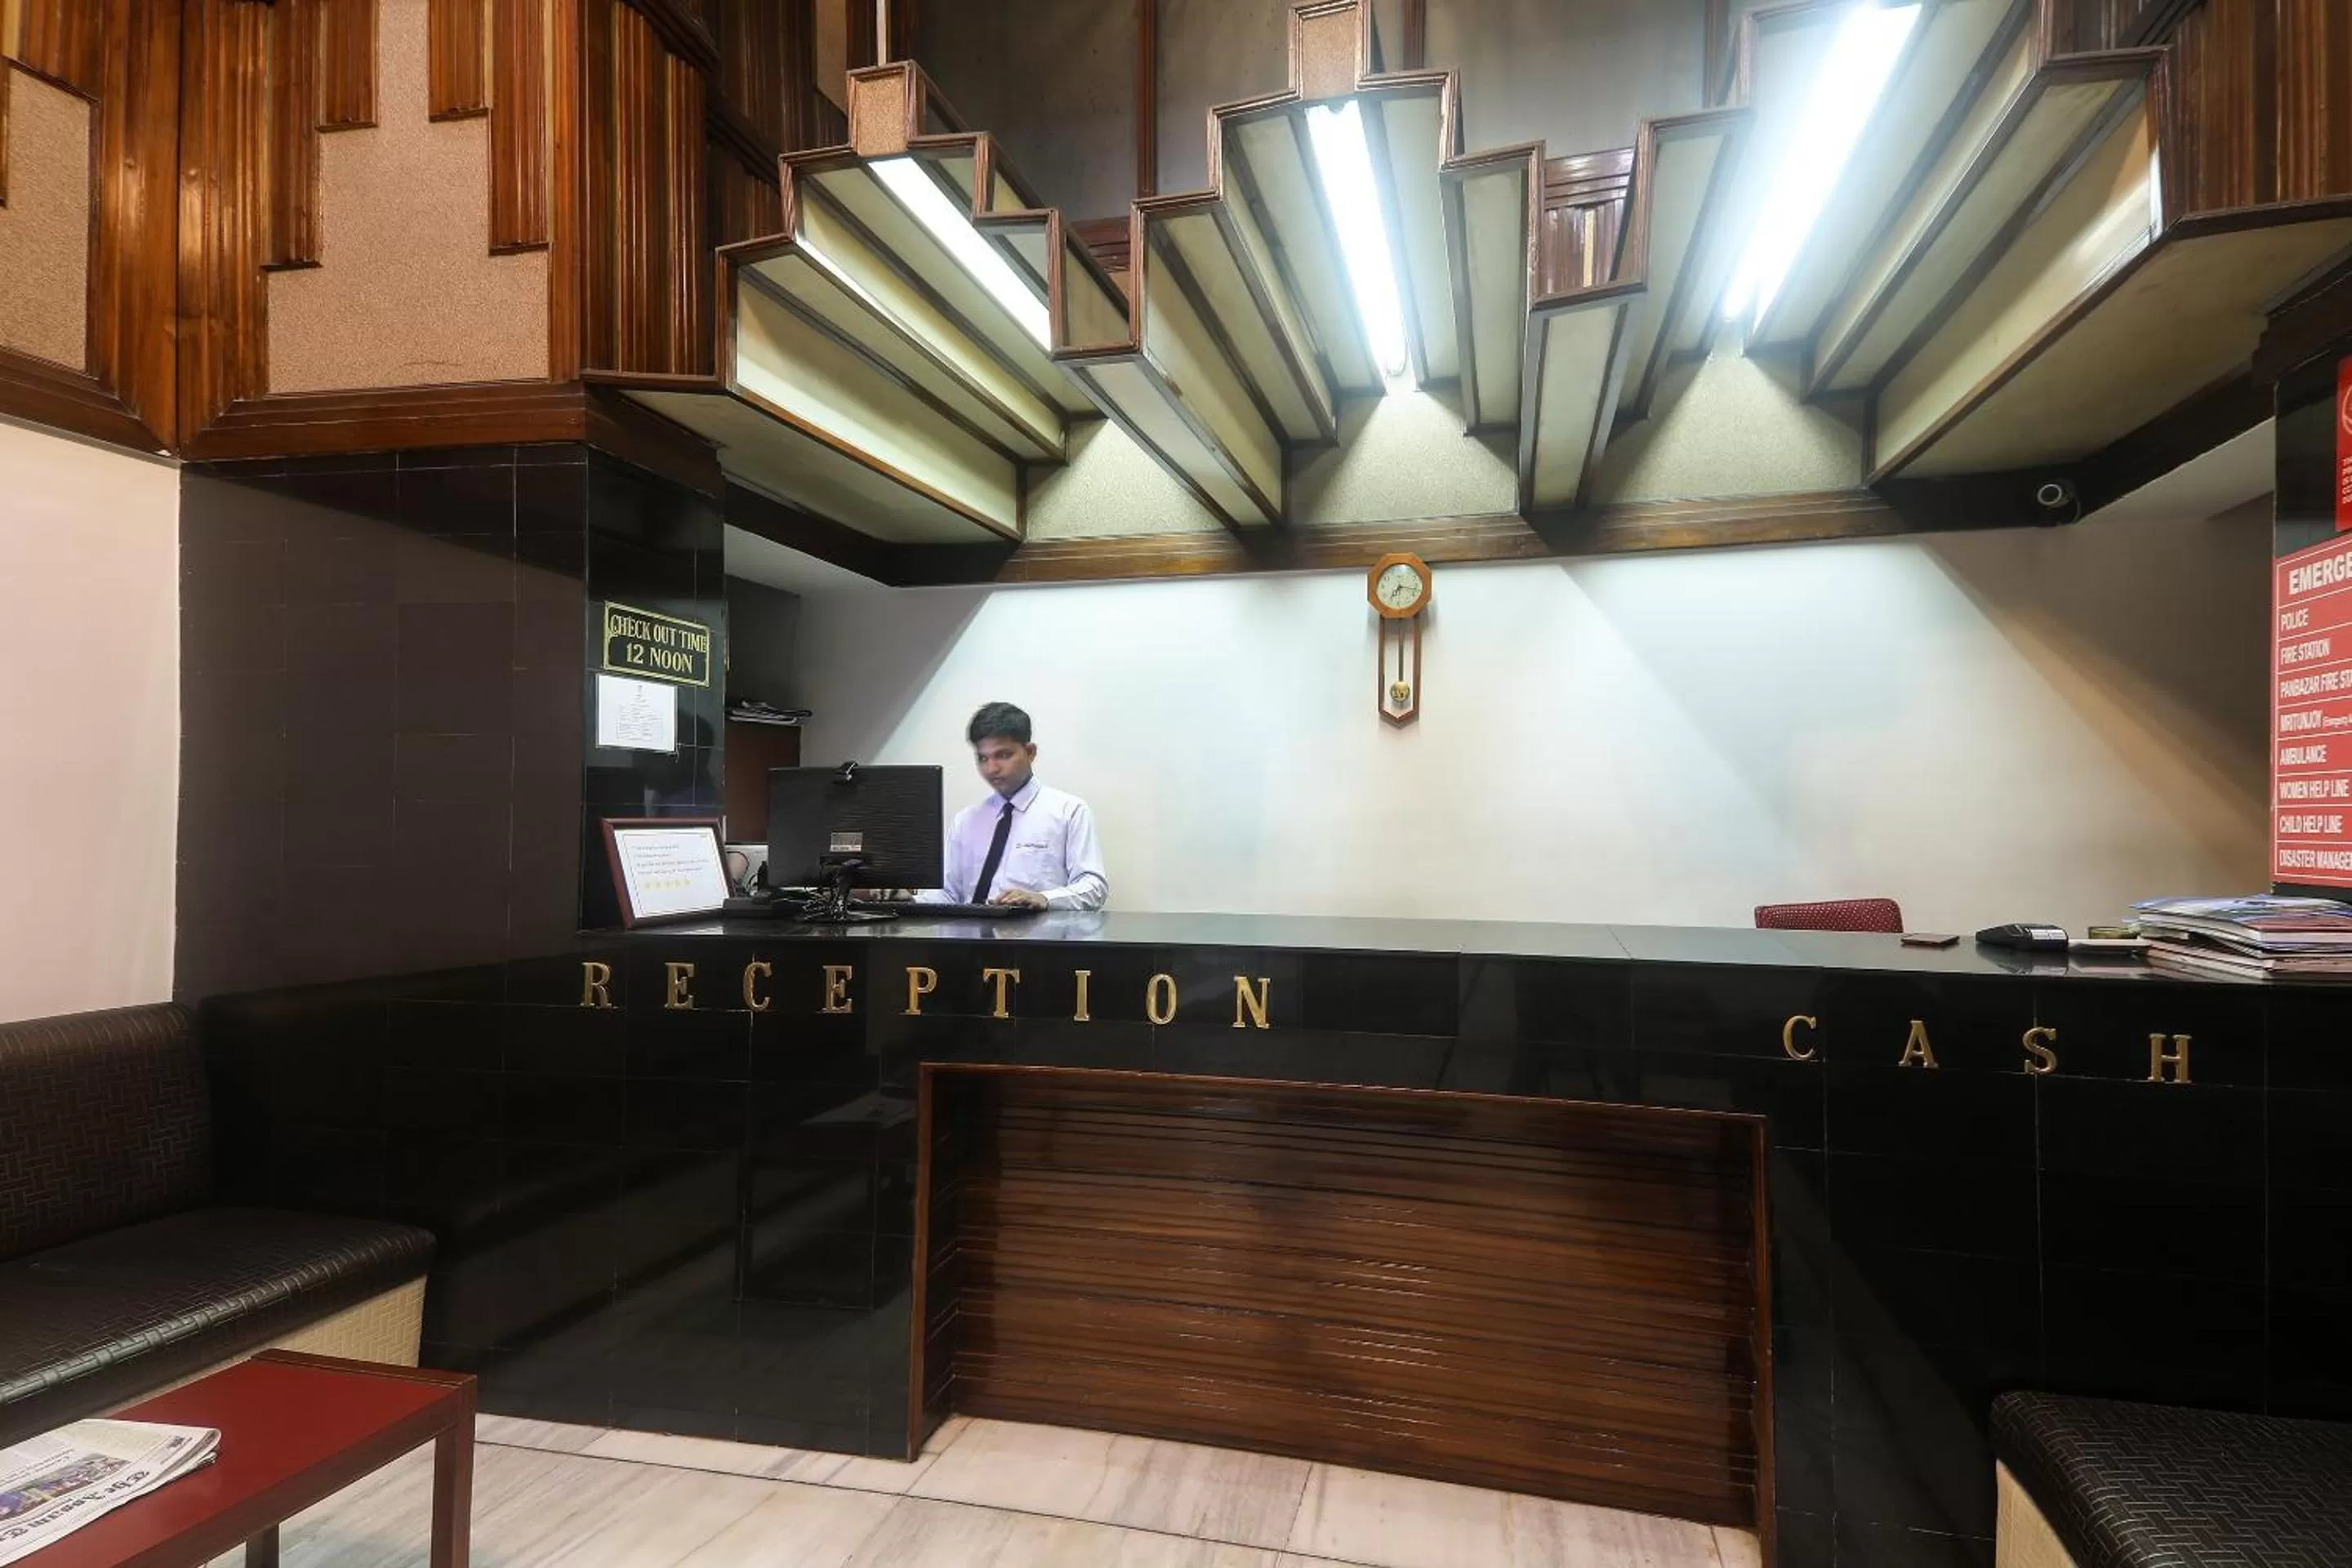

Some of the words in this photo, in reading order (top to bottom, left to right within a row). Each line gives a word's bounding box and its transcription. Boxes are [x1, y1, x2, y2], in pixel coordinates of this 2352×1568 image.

[2281, 608, 2309, 631] POLICE
[610, 614, 652, 640] CHECK
[653, 624, 677, 646] OUT
[679, 630, 706, 653] TIME
[626, 643, 644, 664] 12
[649, 647, 693, 674] NOON
[2281, 645, 2297, 665] FIRE
[2298, 638, 2331, 660] STATION
[2321, 671, 2339, 692] FIRE
[2279, 744, 2327, 765] AMBULANCE
[2279, 781, 2309, 799] WOMEN
[2310, 780, 2329, 799] HELP
[2331, 778, 2350, 797] LINE
[2280, 815, 2302, 833] CHILD
[2303, 815, 2323, 833] HELP
[2324, 815, 2343, 833] LINE
[2280, 849, 2315, 867] DISASTER
[581, 961, 1272, 1030] RECEPTION
[1782, 1015, 2192, 1085] CASH
